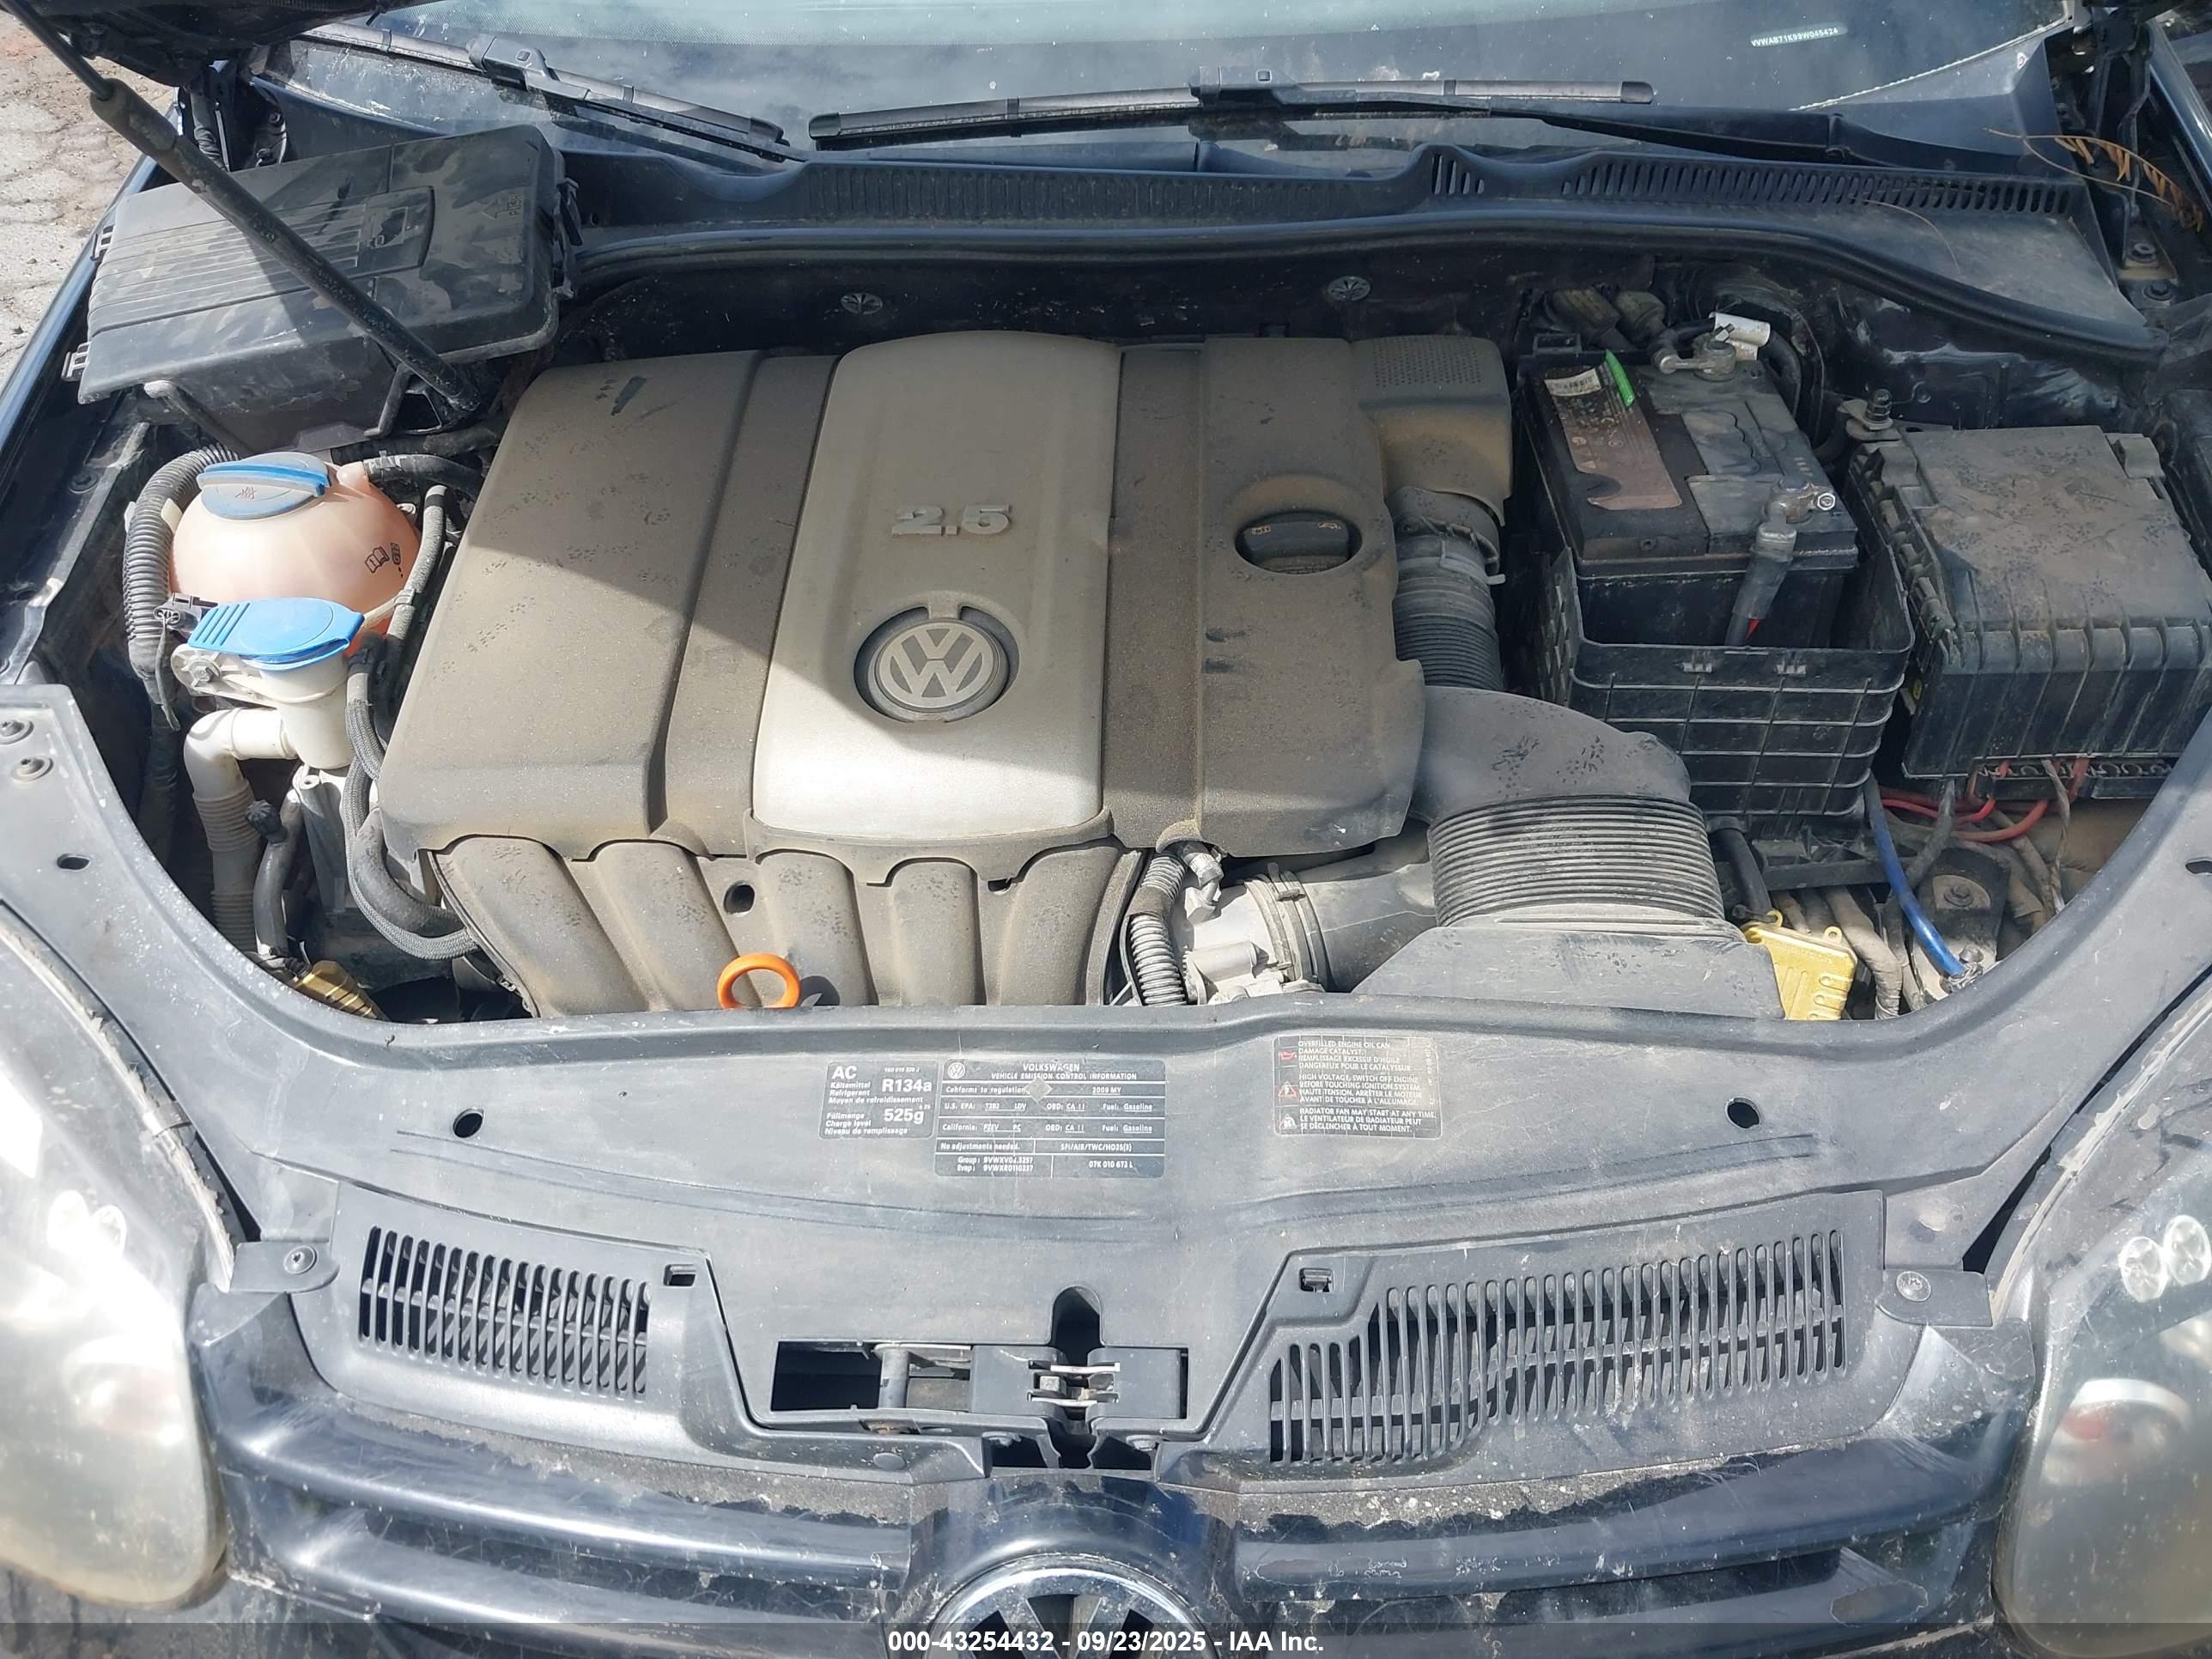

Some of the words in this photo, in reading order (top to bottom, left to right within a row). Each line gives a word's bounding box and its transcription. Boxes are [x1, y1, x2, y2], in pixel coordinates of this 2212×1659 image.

[891, 505, 1011, 536] 2.5
[831, 1065, 857, 1079] AC
[1023, 1063, 1080, 1072] VOLKSWAGEN
[1020, 1072, 1053, 1080] EMISSION
[882, 1078, 933, 1092] R134a
[1355, 1089, 1383, 1097] ARRÊTER
[1394, 1091, 1422, 1099] MOTEUR
[829, 1097, 854, 1105] Moyen
[1367, 1097, 1373, 1105] À
[826, 1112, 866, 1121] Füllmenge
[884, 1108, 925, 1125] 525g
[825, 1120, 852, 1128] Charge
[1123, 1124, 1152, 1133] Gasoline
[1309, 1121, 1352, 1130] DÉCLENCHER
[864, 1127, 908, 1135] remplissage
[951, 1142, 993, 1152] adjustments
[1088, 1160, 1102, 1169] 07K
[1103, 1160, 1115, 1169] 010
